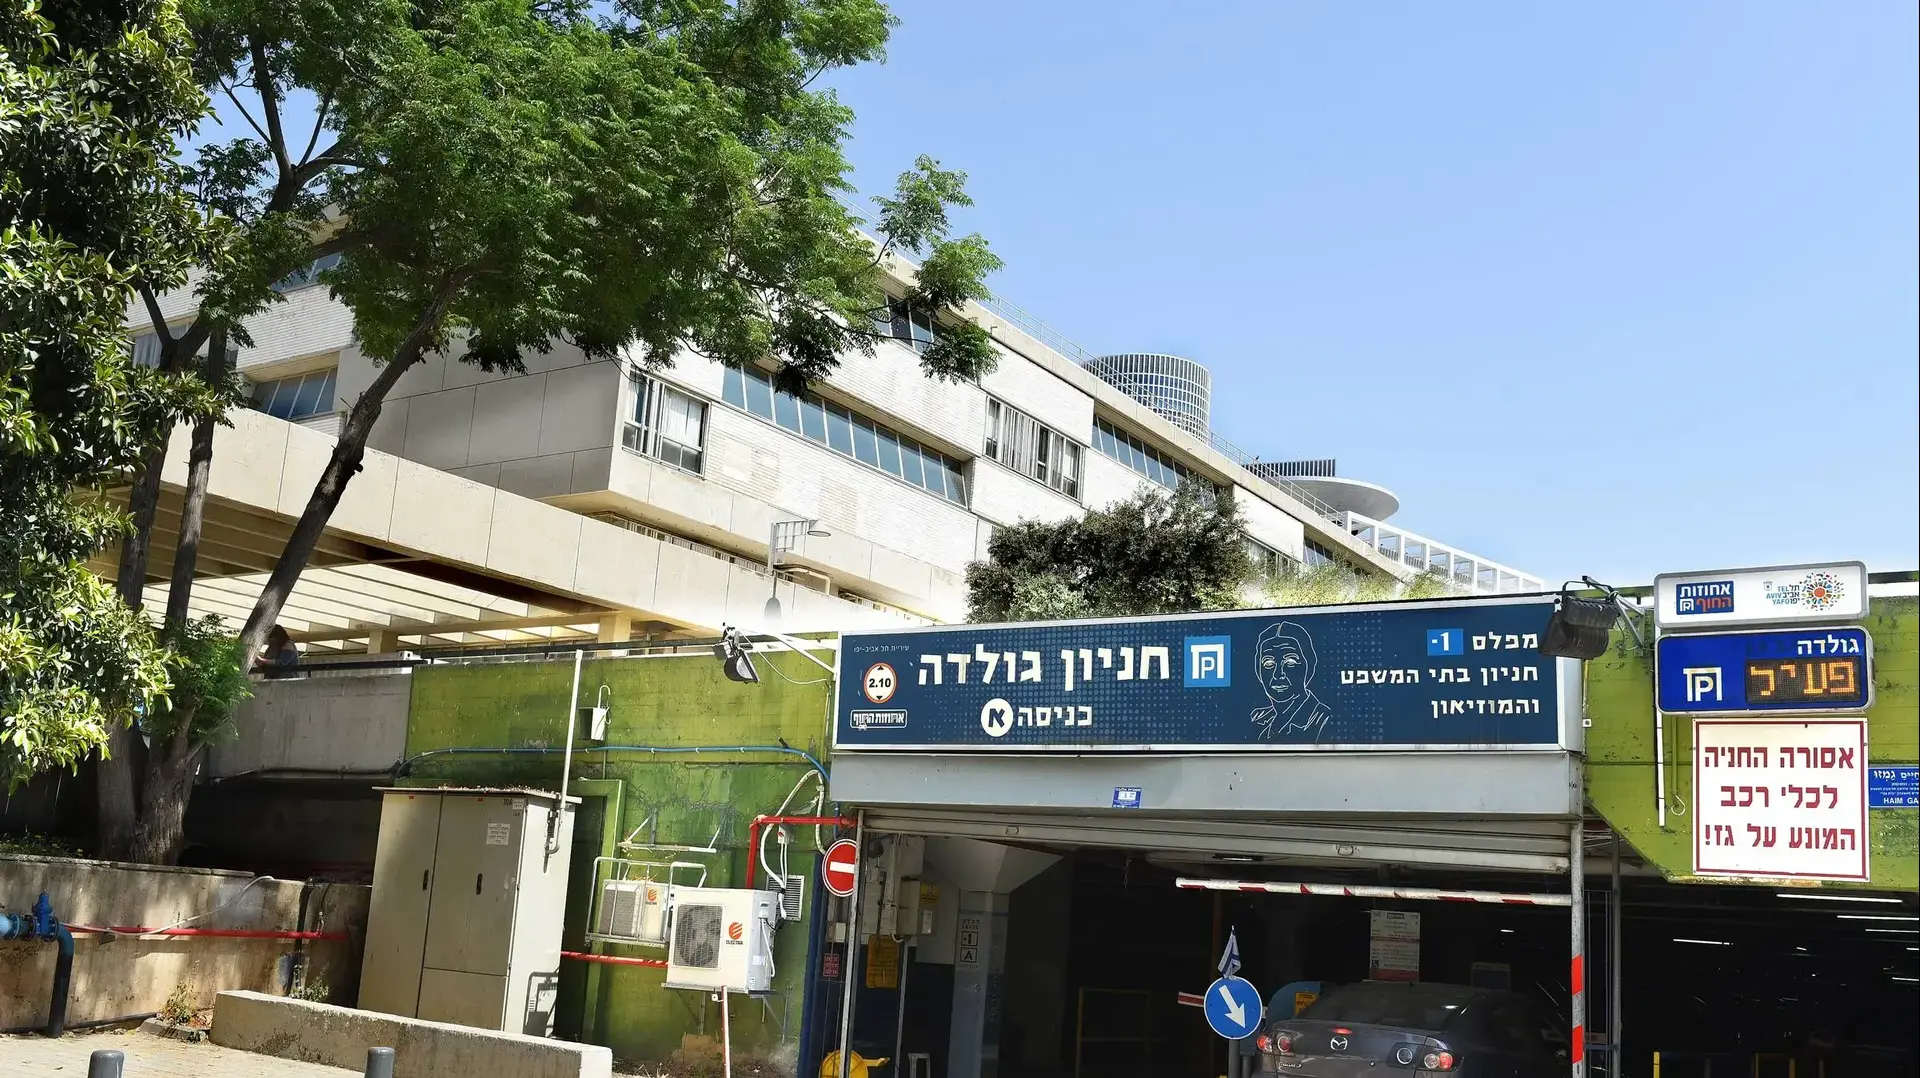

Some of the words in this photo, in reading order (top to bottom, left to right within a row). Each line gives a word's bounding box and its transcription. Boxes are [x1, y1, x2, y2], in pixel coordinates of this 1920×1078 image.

[1680, 583, 1731, 598] אחוזות
[1782, 591, 1800, 599] אביב
[1789, 584, 1800, 592] תל
[1696, 597, 1732, 612] החוף
[1472, 631, 1539, 651] מפלס
[1797, 634, 1860, 655] גולדה
[918, 643, 1043, 685] גולדה
[1060, 645, 1170, 692] חניון
[868, 677, 892, 688] 2.10
[1340, 668, 1420, 686] המשפט
[1428, 667, 1471, 684] בתי
[1480, 666, 1538, 686] חניון
[1750, 661, 1856, 696] פעיל
[988, 708, 1006, 728] א
[1017, 705, 1093, 727] כניסה
[1431, 698, 1540, 719] והמוזיאון
[1704, 746, 1768, 768] החניה
[1779, 746, 1854, 769] אסורה
[1720, 785, 1769, 808] רכב
[1781, 784, 1838, 809] לכלי
[1705, 824, 1735, 846] גז!
[1746, 823, 1777, 848] על
[1788, 828, 1856, 851] המונע
[964, 950, 973, 961] A
